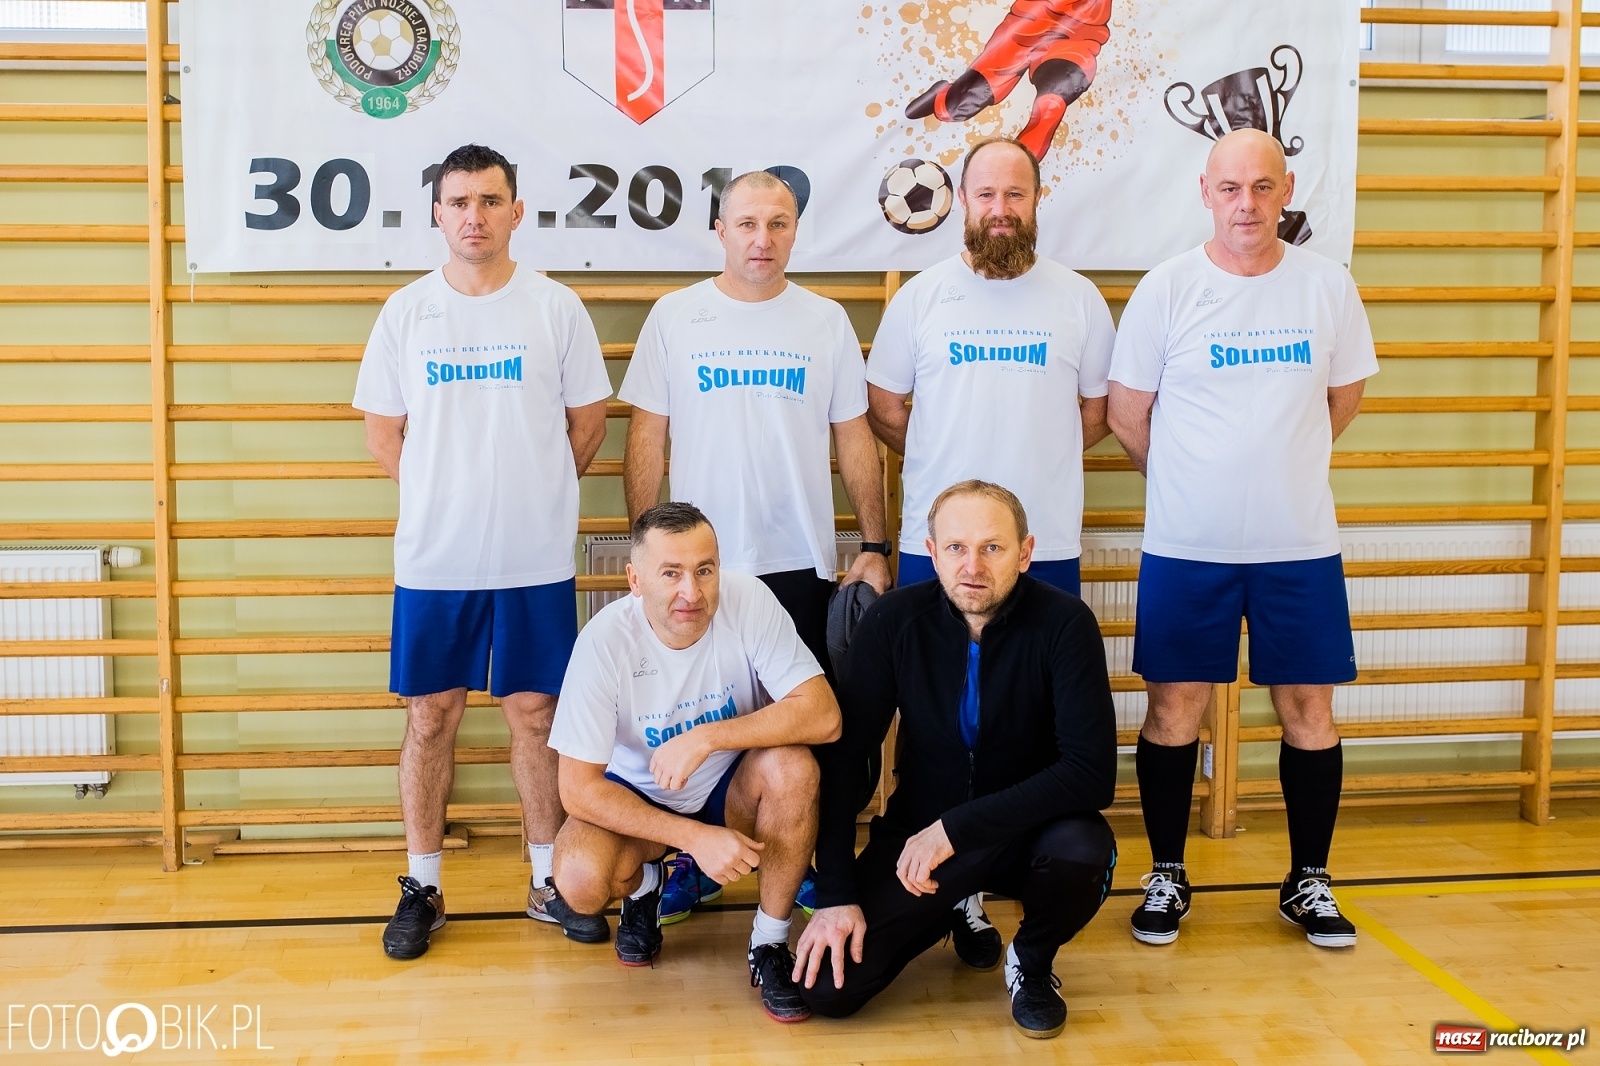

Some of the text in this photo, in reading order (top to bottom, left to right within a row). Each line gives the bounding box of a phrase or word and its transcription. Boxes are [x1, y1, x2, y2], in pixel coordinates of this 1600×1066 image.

[367, 96, 400, 110] 1964
[949, 342, 1047, 367] SOLIDUM
[1210, 340, 1311, 369] SOLIDUM
[426, 356, 522, 386] SOLIDUM
[697, 365, 806, 395] SOLIDUM
